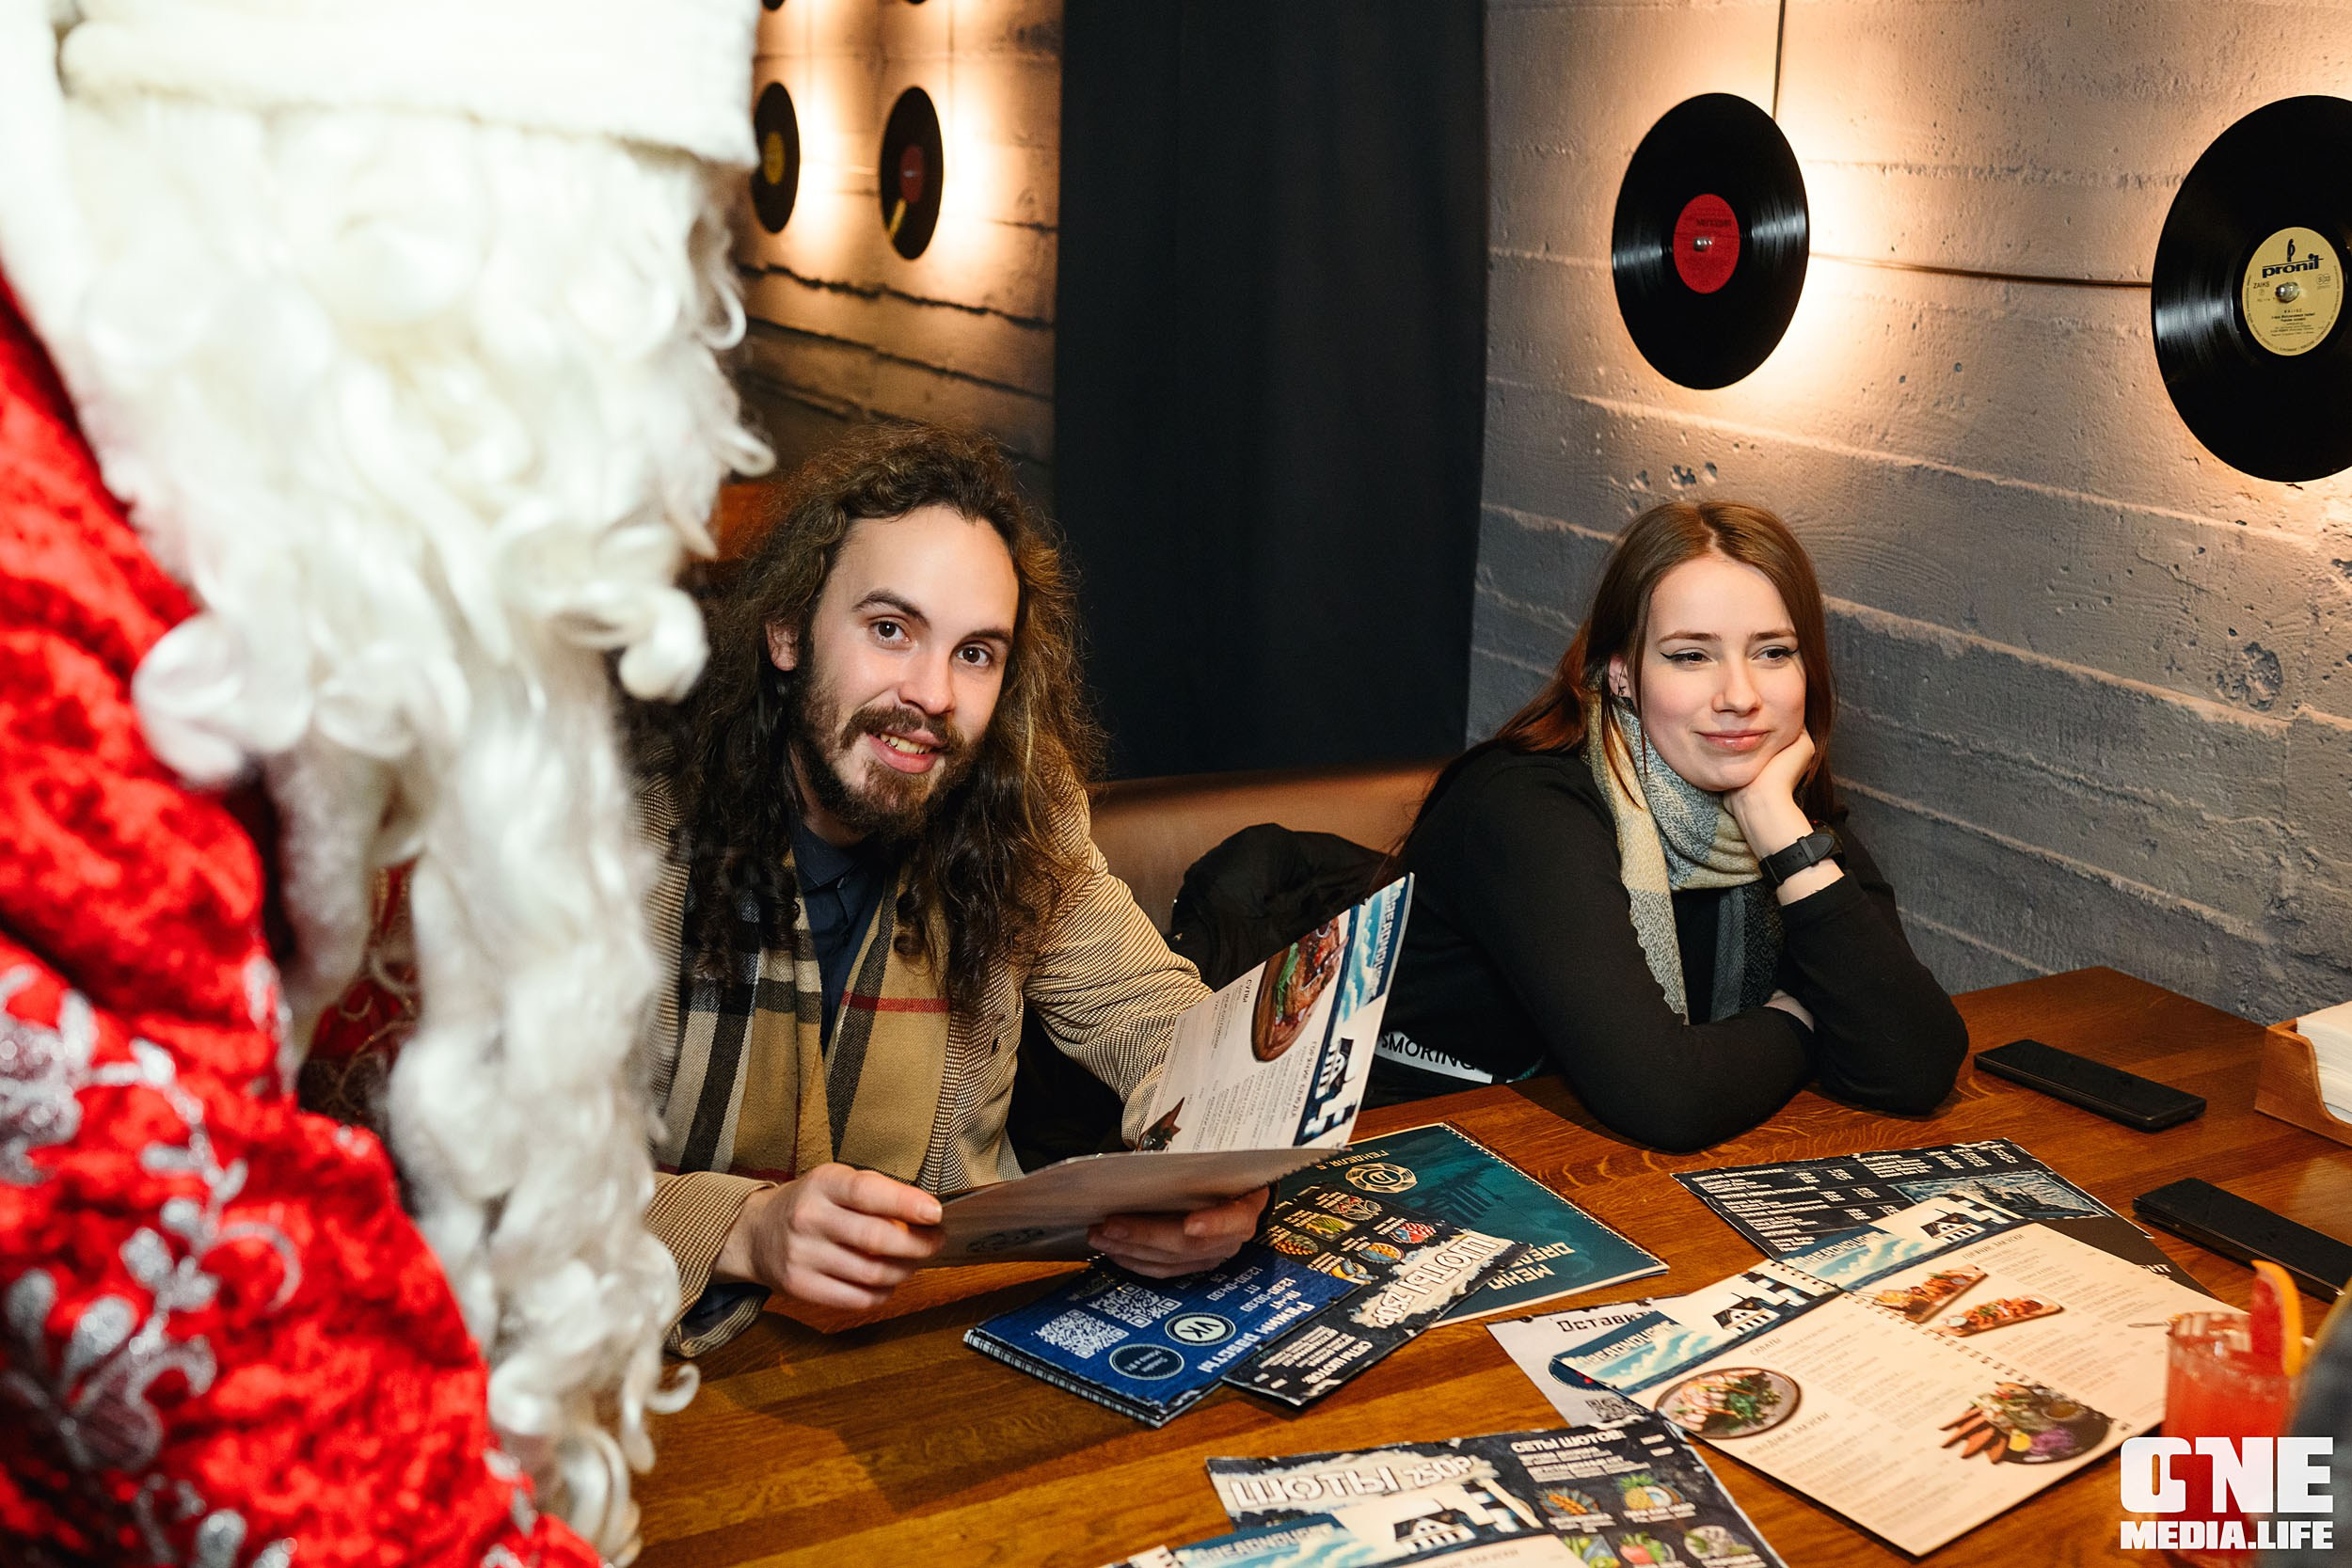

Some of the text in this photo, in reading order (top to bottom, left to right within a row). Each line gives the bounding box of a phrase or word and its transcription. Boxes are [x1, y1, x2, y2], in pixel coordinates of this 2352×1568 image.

[2263, 253, 2320, 278] pronit
[1398, 1235, 1499, 1295] ШОТЫ
[1240, 1277, 1296, 1313] 12:00-00:00
[1245, 1284, 1261, 1294] ПТ
[1511, 1437, 1560, 1453] СЕТЫ
[1229, 1465, 1402, 1508] ШОТЫ
